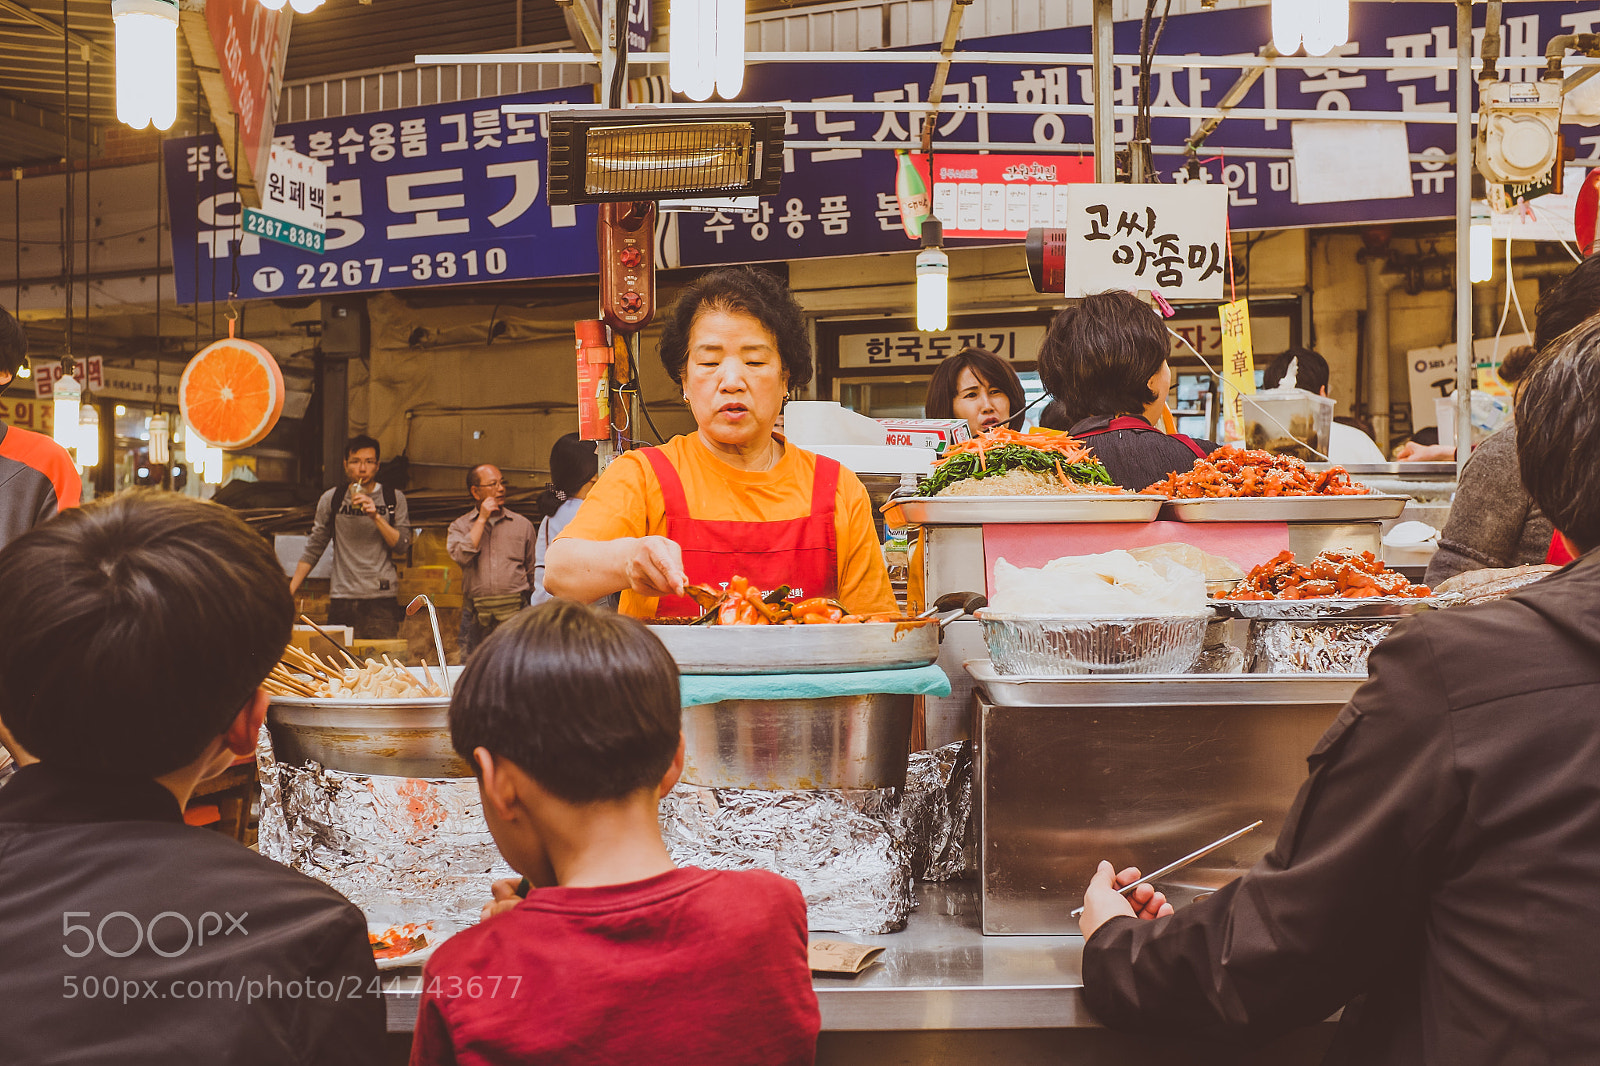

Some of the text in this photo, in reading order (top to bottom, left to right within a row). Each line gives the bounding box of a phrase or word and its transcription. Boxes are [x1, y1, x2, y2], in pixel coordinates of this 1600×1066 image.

[247, 214, 321, 251] 2267-8383
[1083, 203, 1157, 241] 고씨
[296, 247, 508, 290] 2267-3310
[897, 435, 913, 447] FOIL
